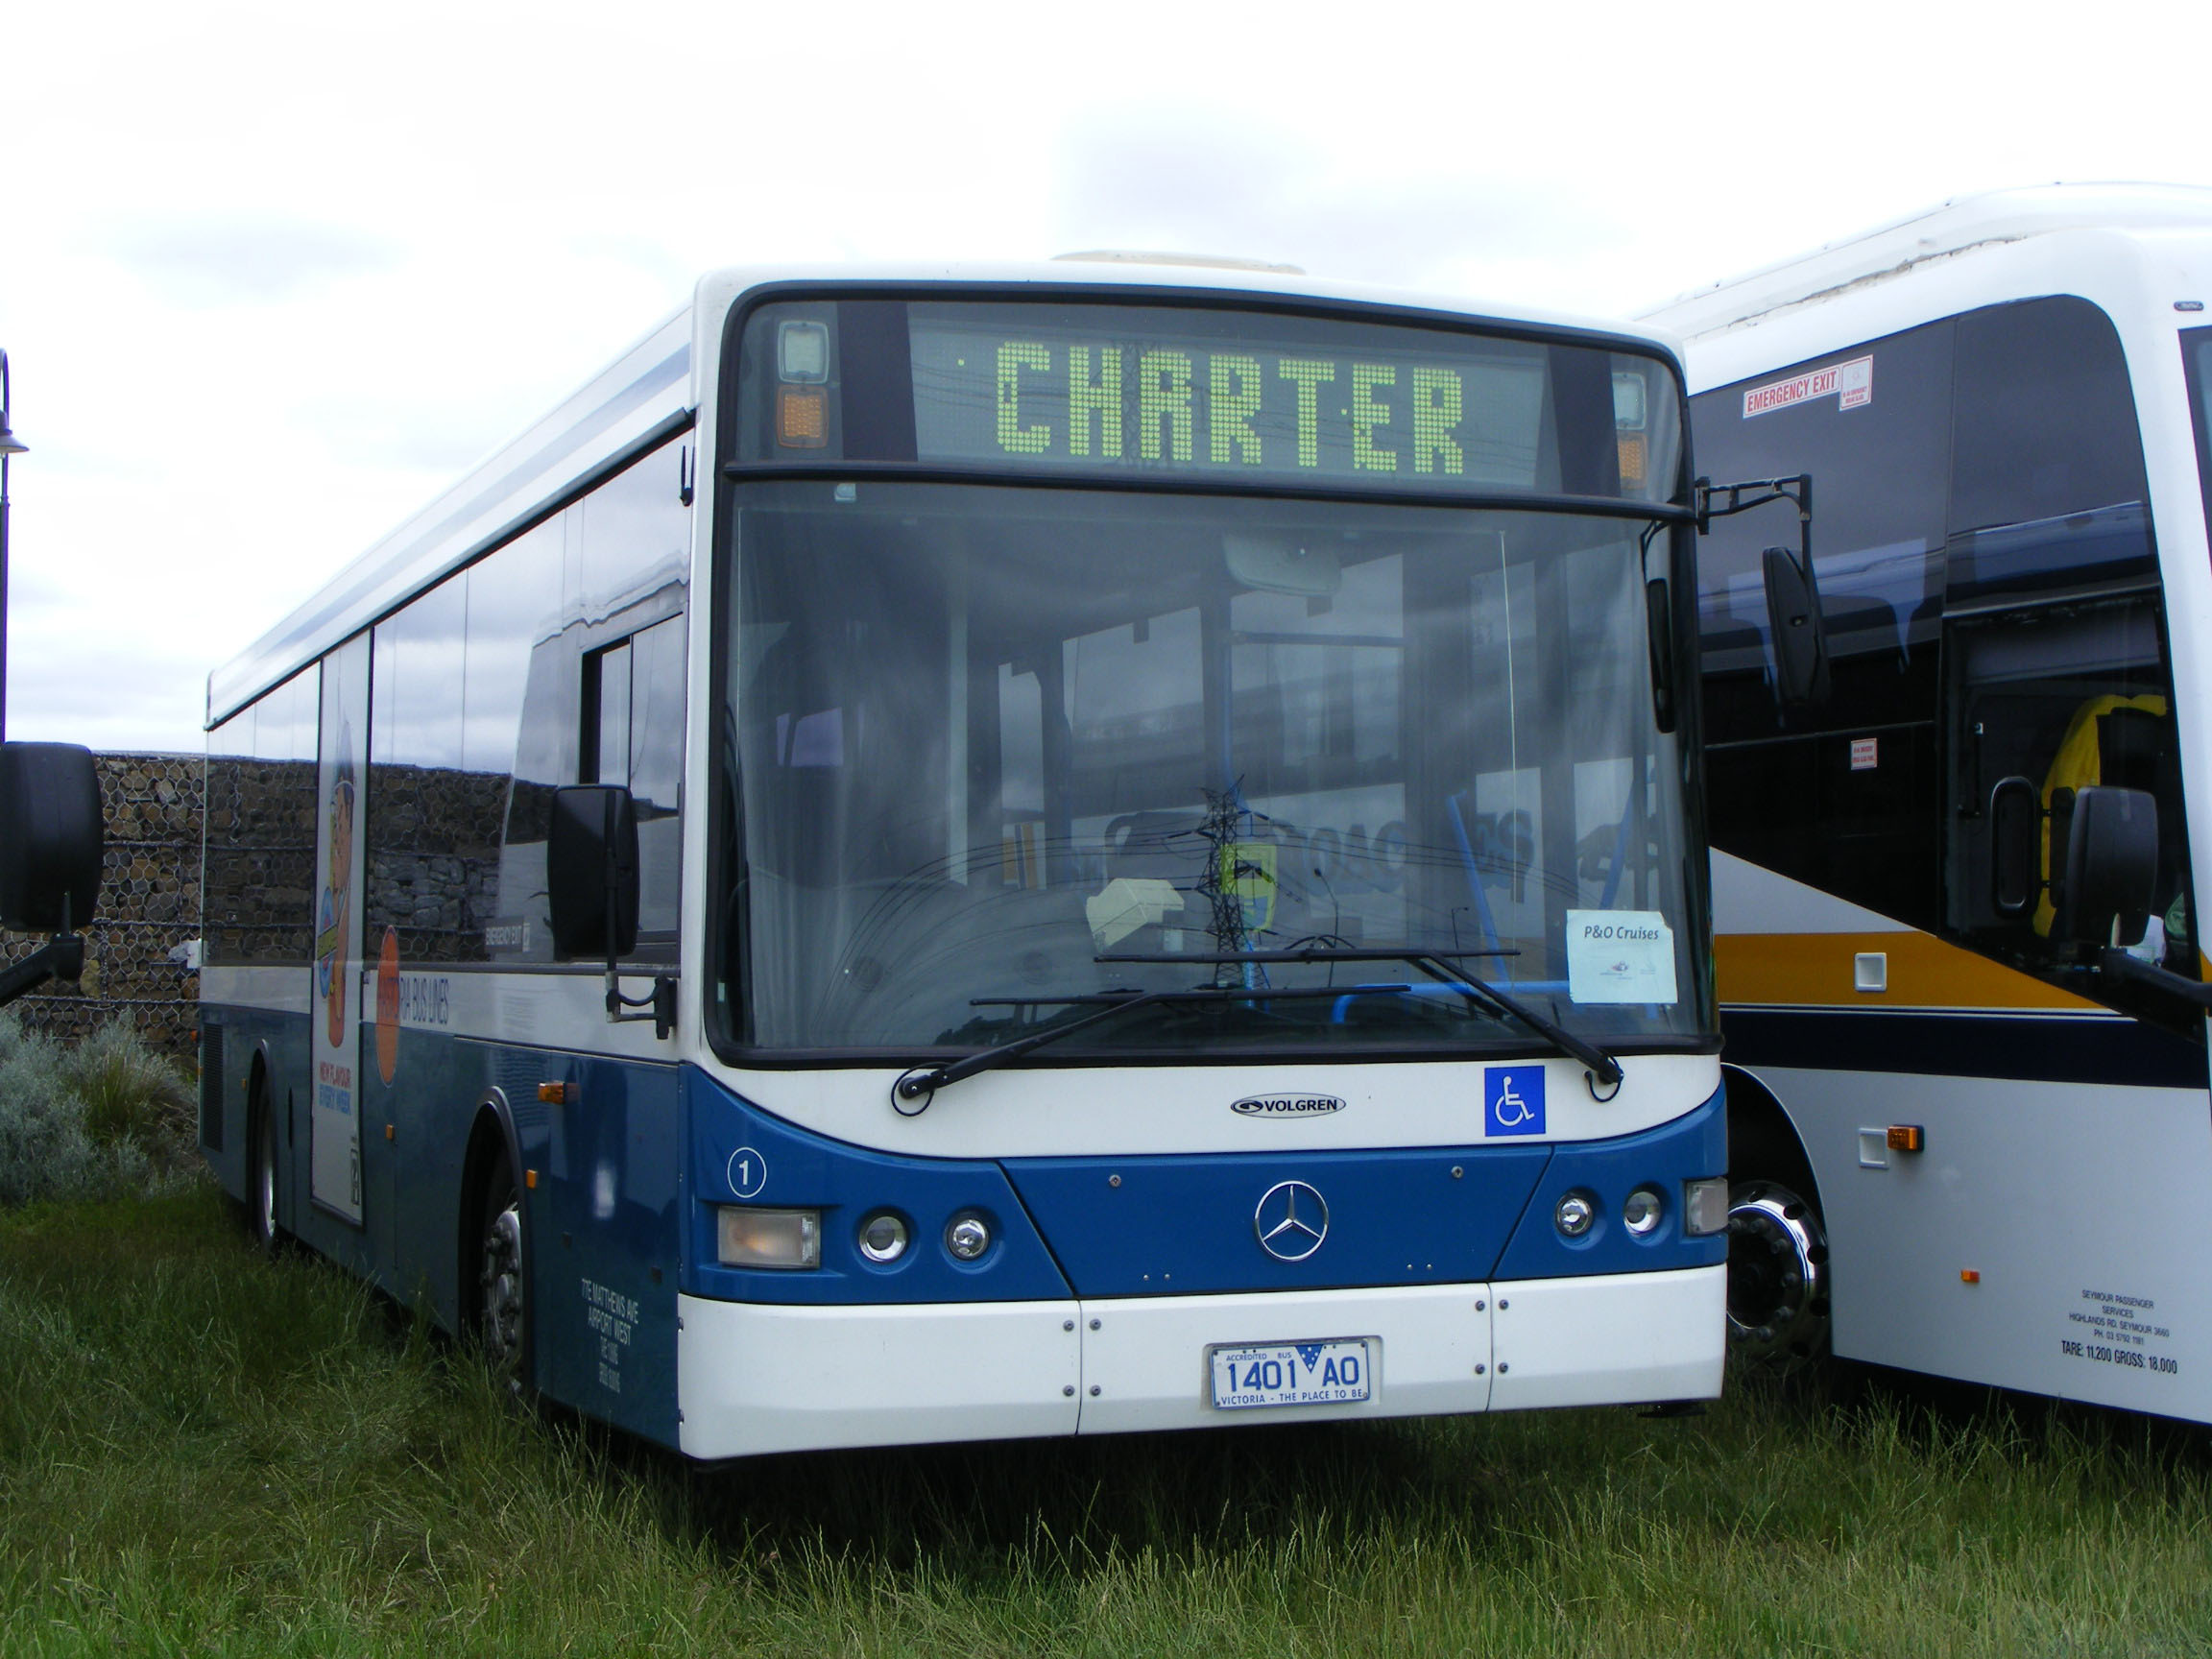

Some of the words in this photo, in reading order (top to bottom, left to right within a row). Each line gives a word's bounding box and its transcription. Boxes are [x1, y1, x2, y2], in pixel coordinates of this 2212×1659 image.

[1747, 378, 1810, 413] EMERGENCY
[1813, 371, 1837, 394] EXIT
[998, 341, 1463, 474] CHARTER
[1584, 926, 1613, 939] P&O
[1617, 926, 1659, 940] Cruises
[413, 977, 427, 1022] BUS
[428, 977, 449, 1025] LINES
[1264, 1099, 1337, 1112] VOLGREN
[738, 1160, 749, 1186] 1
[2081, 1289, 2113, 1303] SEYMOUR
[2115, 1294, 2154, 1310] PASSENGER
[2102, 1306, 2134, 1318] SERVICES
[613, 1317, 632, 1346] WEST
[2069, 1312, 2105, 1326] HIGHLANDS
[2119, 1320, 2152, 1334] SEYMOUR
[1226, 1352, 1267, 1361] ACCREDITED
[2114, 1349, 2147, 1369] GROSS:
[1228, 1359, 1296, 1392] 1401
[1221, 1394, 1265, 1406] VICTORIA
[1279, 1393, 1296, 1402] THE
[1302, 1390, 1330, 1401] PLACE
[1334, 1390, 1347, 1399] TO
[1351, 1388, 1362, 1398] BE
